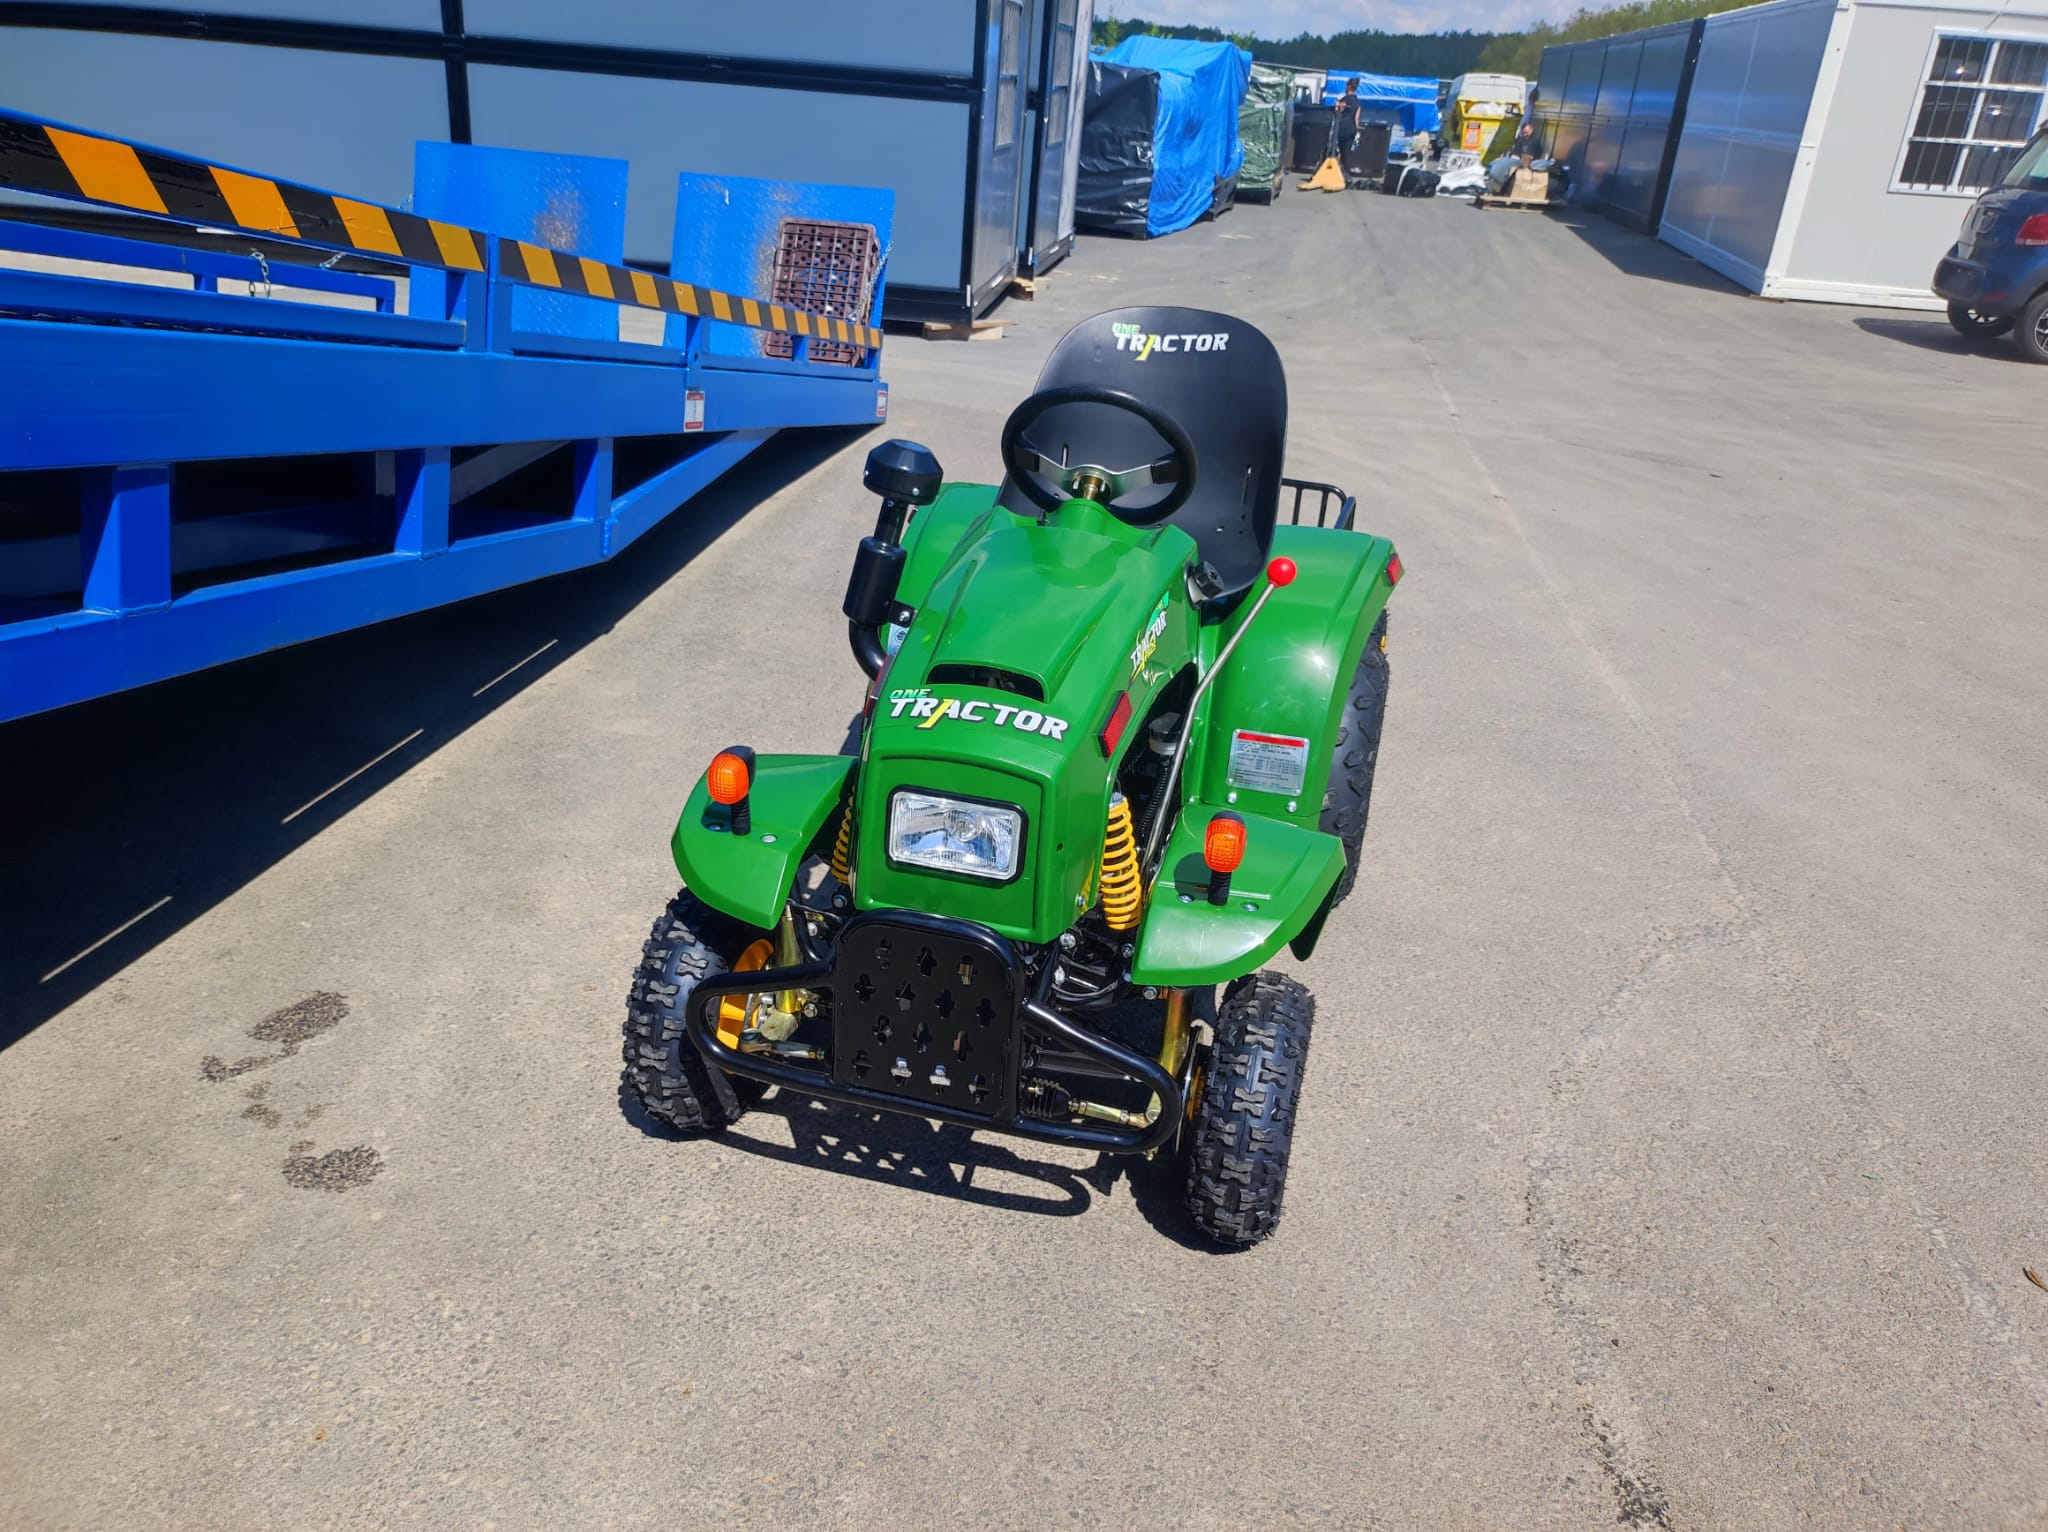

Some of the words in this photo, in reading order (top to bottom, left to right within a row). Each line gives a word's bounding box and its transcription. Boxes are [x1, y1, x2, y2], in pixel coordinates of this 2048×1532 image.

[1112, 322, 1141, 334] ONE
[1114, 333, 1229, 361] TRACTOR
[889, 688, 931, 699] ONE
[890, 698, 1069, 740] TRACTOR
